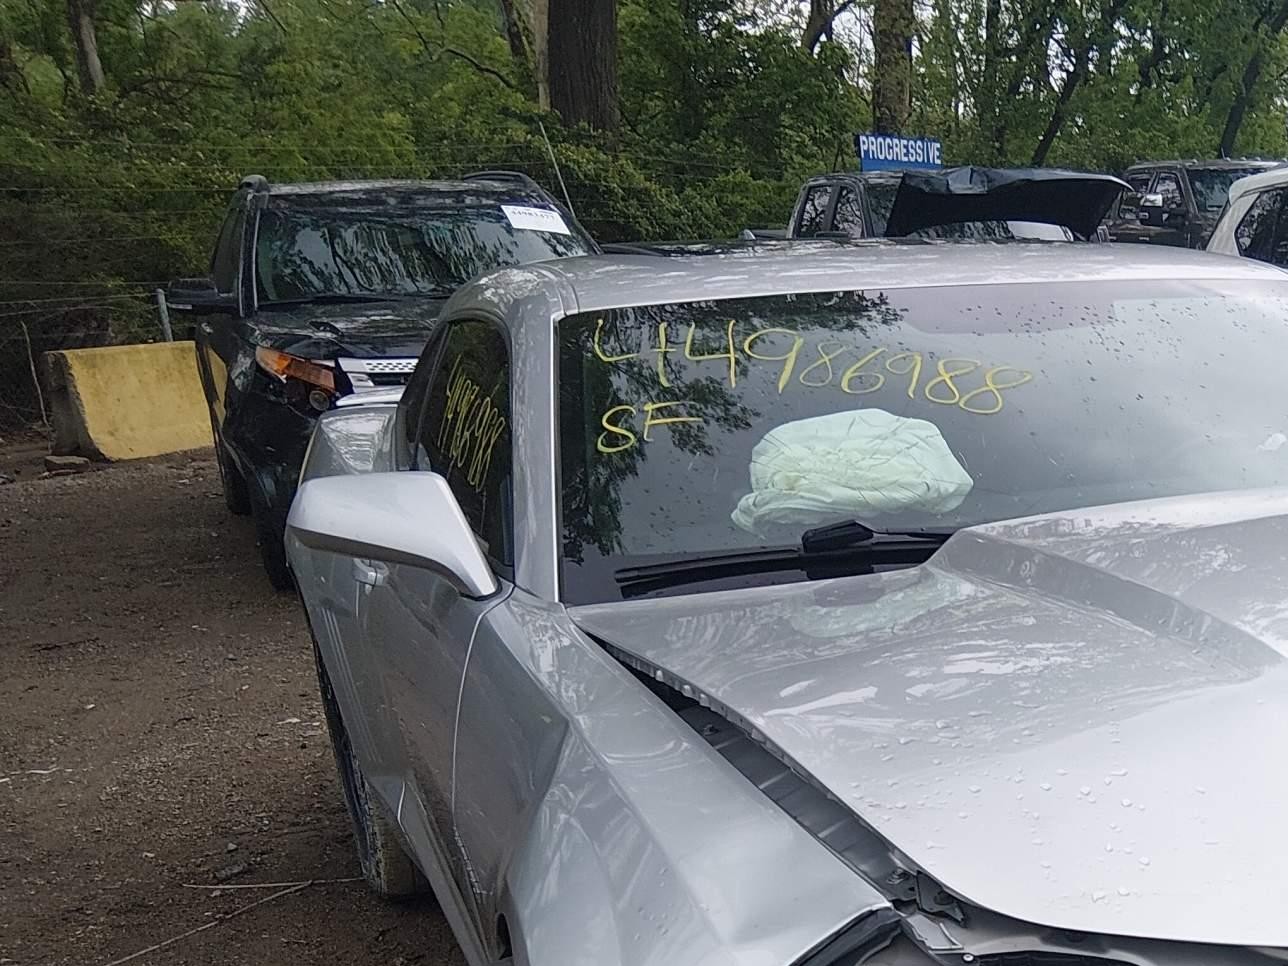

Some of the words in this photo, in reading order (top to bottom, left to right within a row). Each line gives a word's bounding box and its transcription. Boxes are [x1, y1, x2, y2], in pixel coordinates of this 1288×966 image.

[859, 135, 942, 165] PROGRESSIVE
[593, 319, 1032, 414] 44986988
[597, 401, 702, 453] SF
